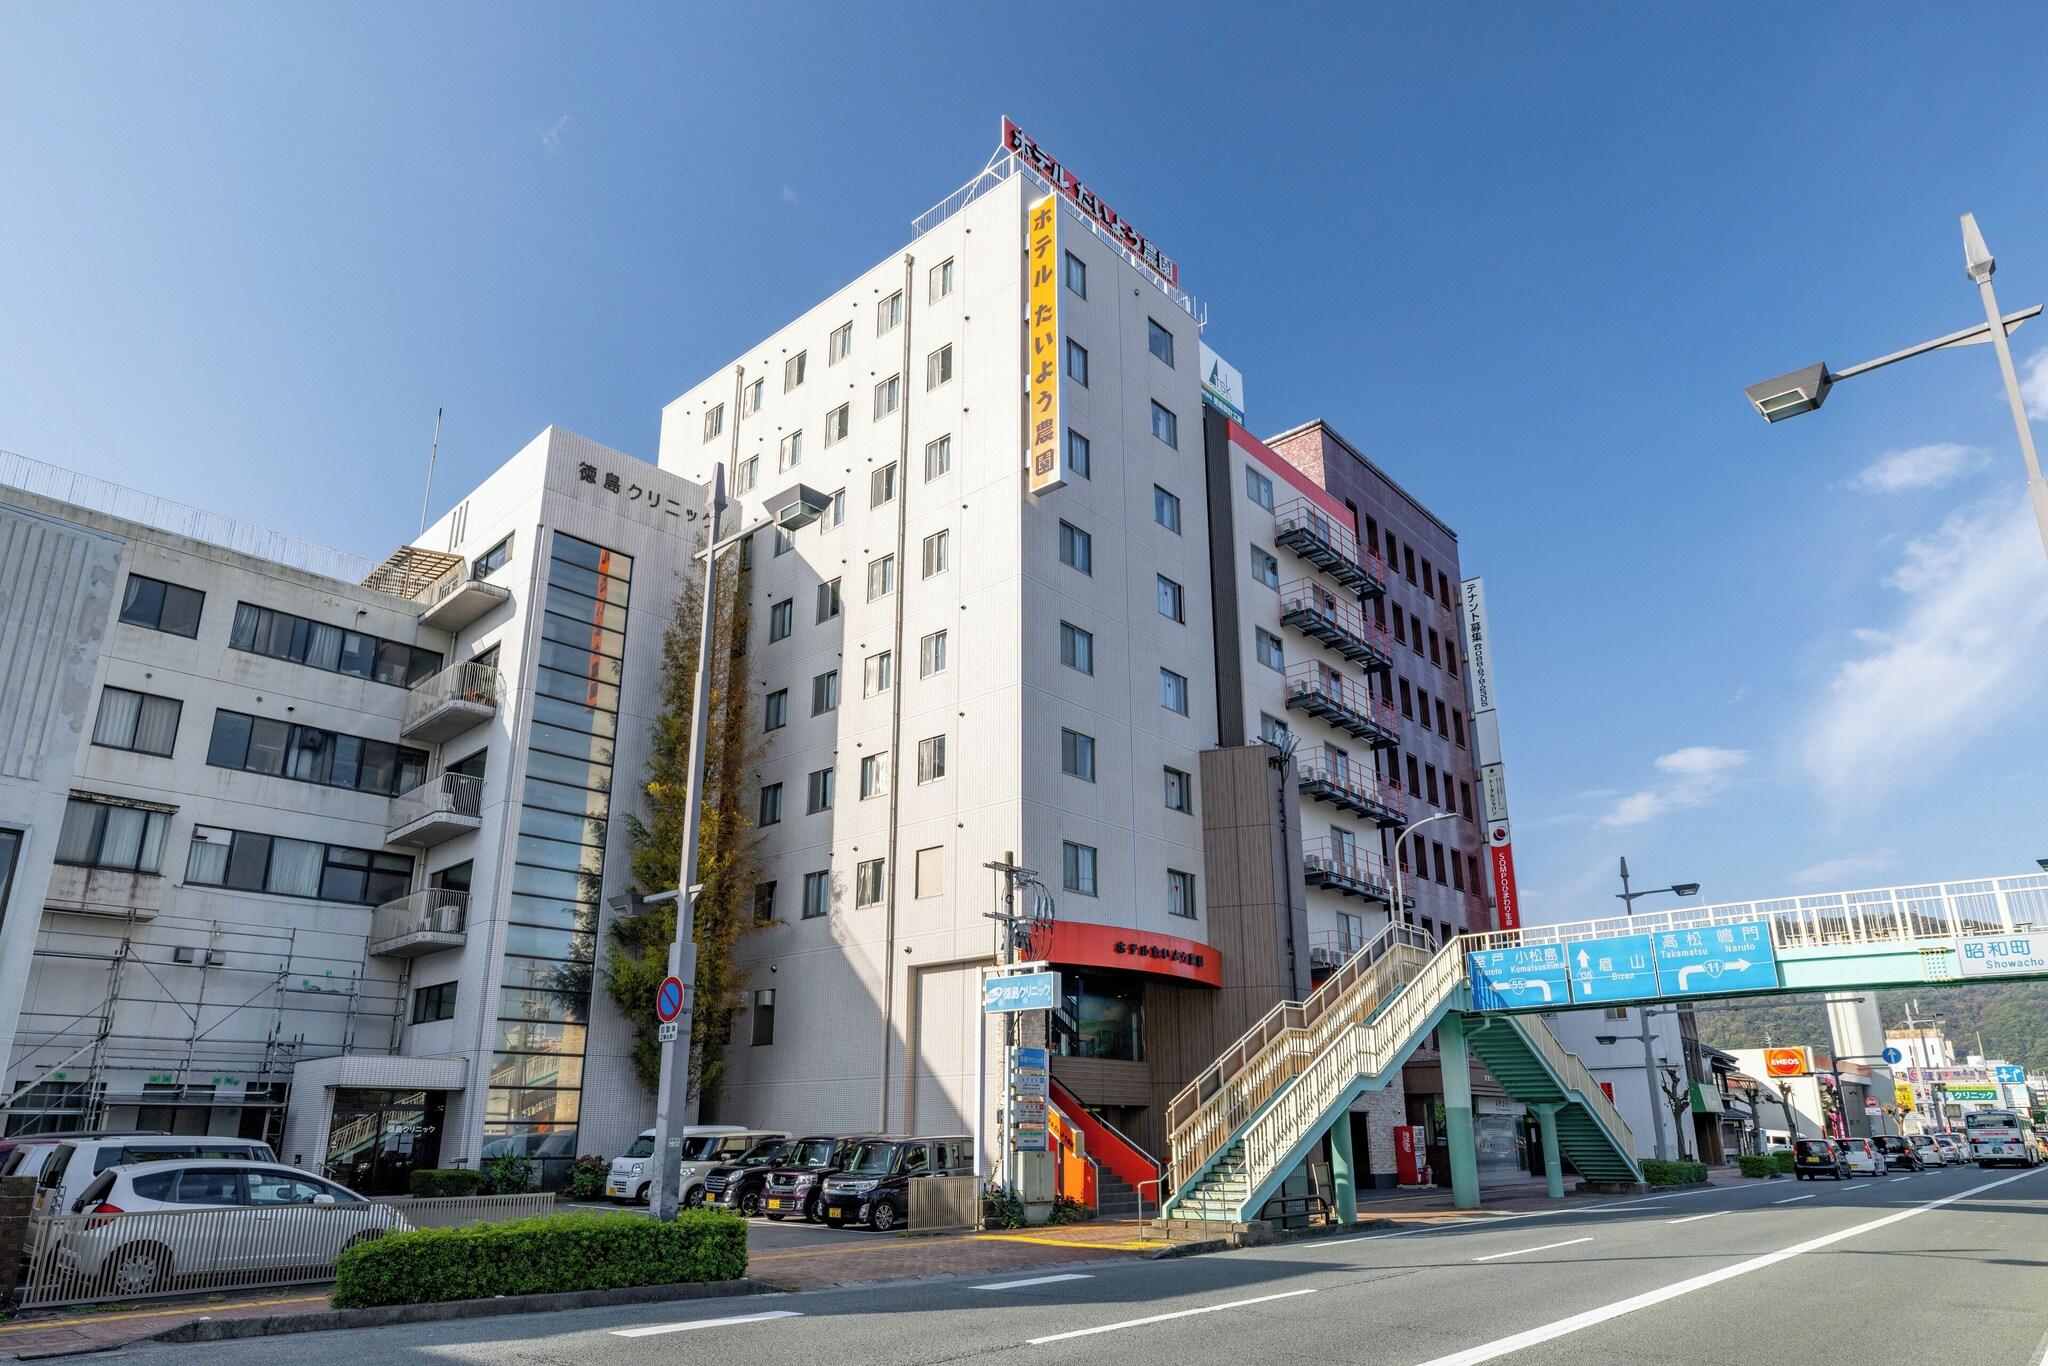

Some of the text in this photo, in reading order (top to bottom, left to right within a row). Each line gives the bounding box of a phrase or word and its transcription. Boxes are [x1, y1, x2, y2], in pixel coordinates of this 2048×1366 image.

[1013, 128, 1070, 191] ホテル
[1034, 207, 1055, 477] ホテル たいよう農園
[1466, 583, 1483, 643] テナント募集
[1498, 852, 1513, 926] SOMPOひまわり生命
[1661, 925, 1760, 949] 高松 鳴門
[1514, 947, 1558, 965] 小松島
[1660, 942, 1756, 960] Takamatsu Naruto
[1964, 939, 2031, 959] 昭和町
[1510, 962, 1564, 974] Komatsushima
[1708, 961, 1720, 974] 11
[1986, 957, 2045, 969] Showacho
[1511, 981, 1525, 990] 55
[1611, 972, 1635, 981] Bizan
[1770, 1058, 1800, 1066] ENEOS
[1954, 1091, 1994, 1100] クリニック
